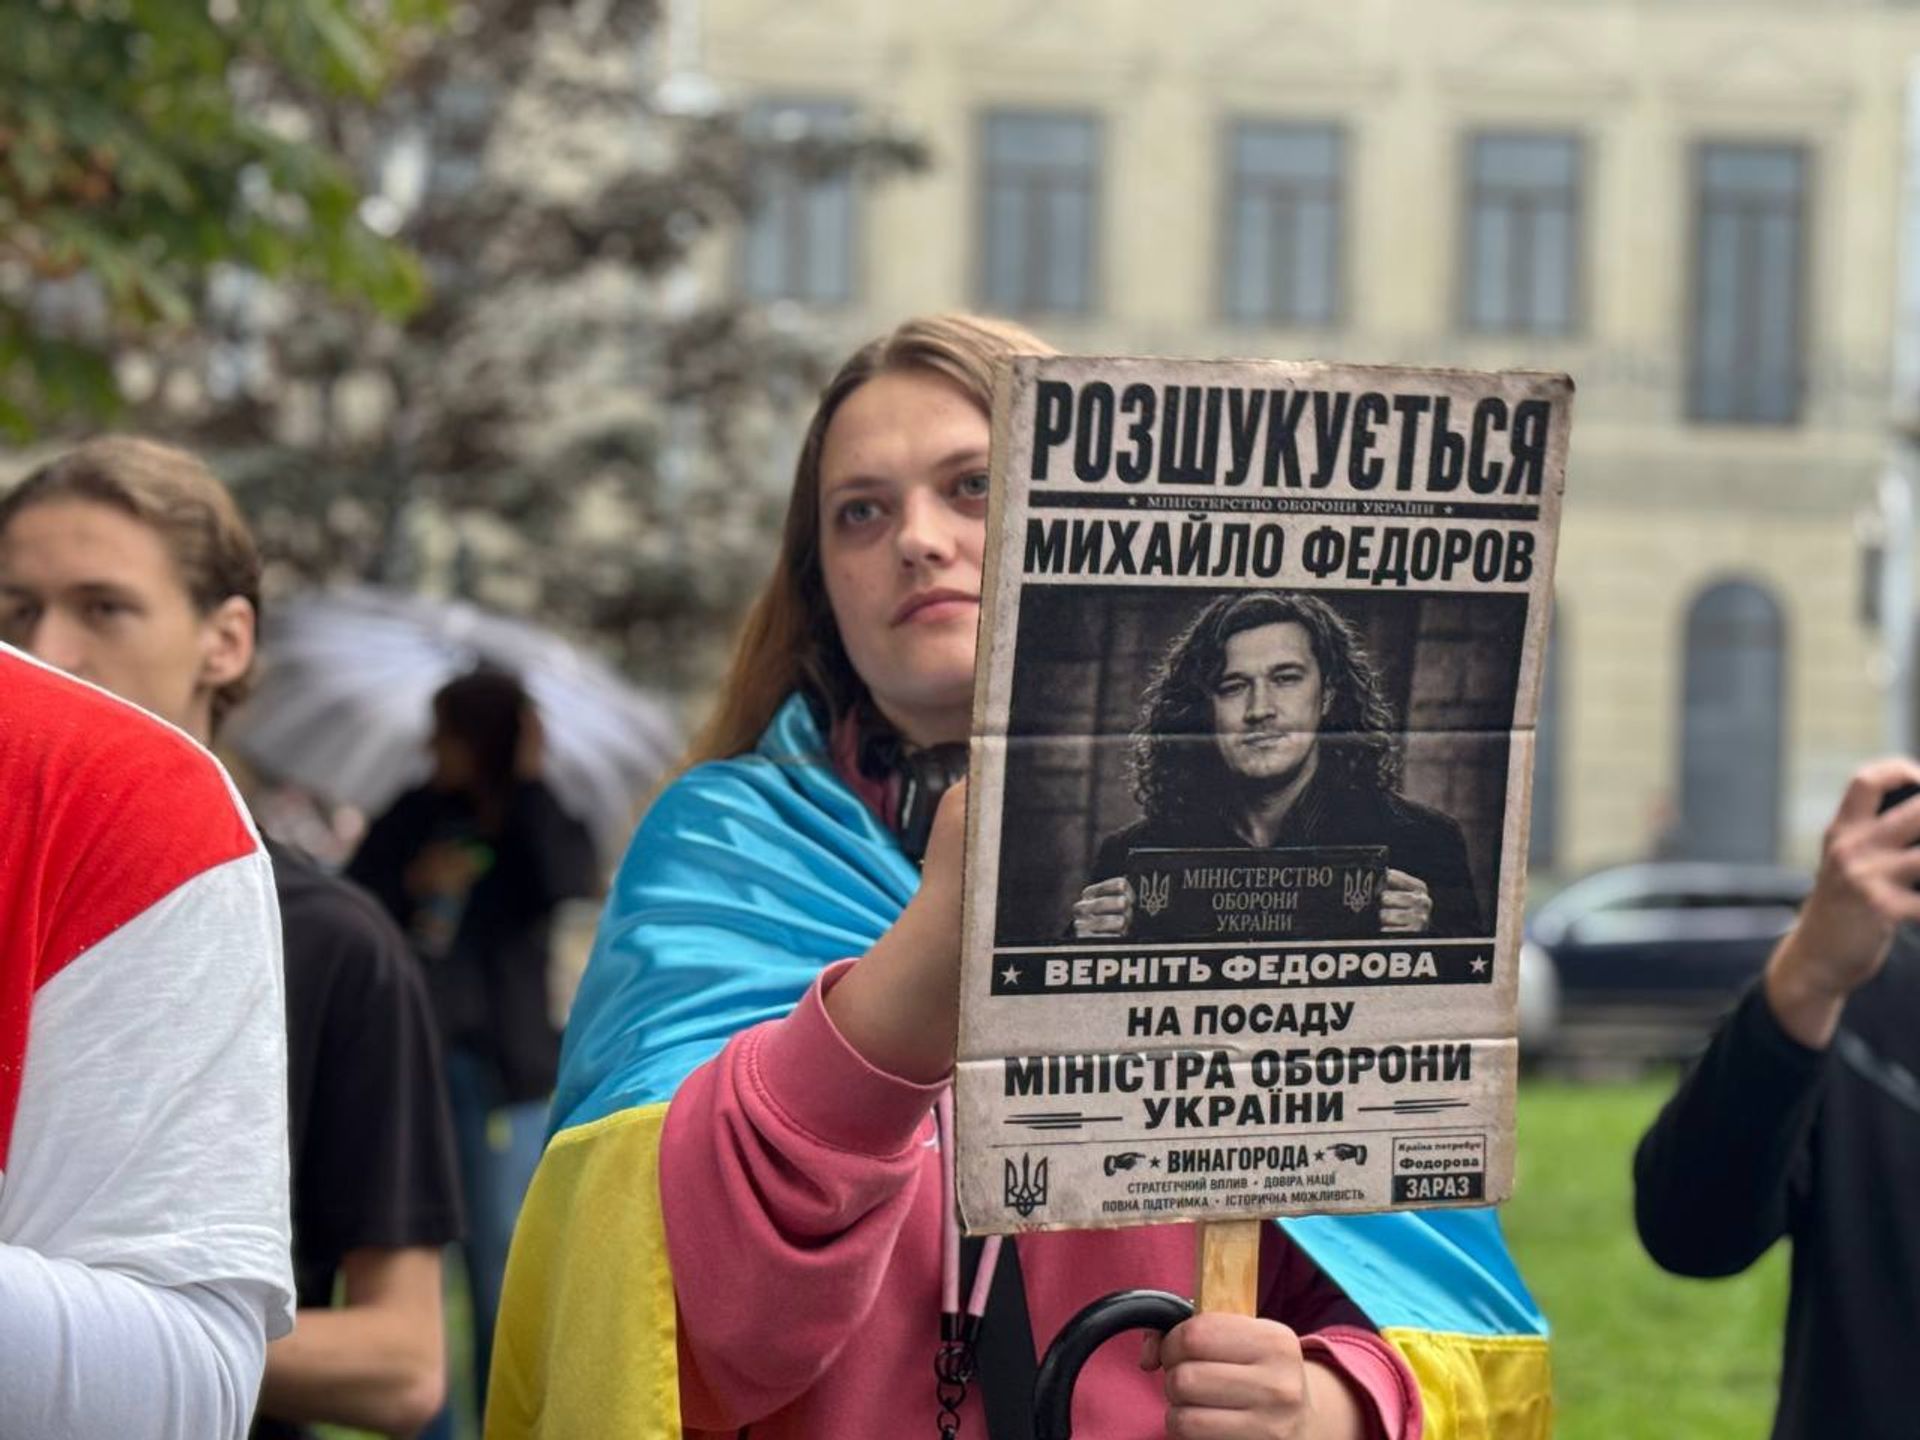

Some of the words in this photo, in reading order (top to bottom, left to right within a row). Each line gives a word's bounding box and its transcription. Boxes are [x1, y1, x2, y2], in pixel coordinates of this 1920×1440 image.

[1030, 379, 1551, 496] РОЗШУКУЄТЬСЯ
[1147, 496, 1272, 512] МІНІСТЕРСТВО
[1277, 501, 1357, 514] ОБОРОНИ
[1362, 503, 1436, 516] УКРАЇНИ
[1022, 511, 1285, 578] МИХАЙЛО
[1300, 525, 1536, 586] ФЕДОРОВ
[1183, 867, 1334, 890] МІНІСТЕРСТВО
[1211, 891, 1298, 911] ОБОРОНИ
[1216, 911, 1293, 933] УКРАЇНИ
[1044, 957, 1212, 987] ВЕРНІТЬ
[1220, 951, 1438, 985] ФЕДОРОВА
[1126, 1006, 1182, 1037] НА
[1193, 1001, 1355, 1037] ПОСАДУ
[1003, 1050, 1236, 1097] МІНІСТРА
[1250, 1043, 1472, 1088] ОБОРОНИ
[1142, 1089, 1345, 1130] УКРАЇНИ
[1166, 1145, 1309, 1174] ВИНАГОРОДА
[1210, 1177, 1249, 1191] ВПЛИВ
[1263, 1175, 1304, 1189] ДОВІРА
[1405, 1176, 1471, 1198] ЗАРАЗ
[1102, 1200, 1140, 1213] ПОВНА
[1143, 1196, 1209, 1211] ПІДТРИМКА
[1225, 1192, 1288, 1207] ІСТОРИЧНА
[1290, 1189, 1365, 1204] МОЖЛИВІСТЬ
